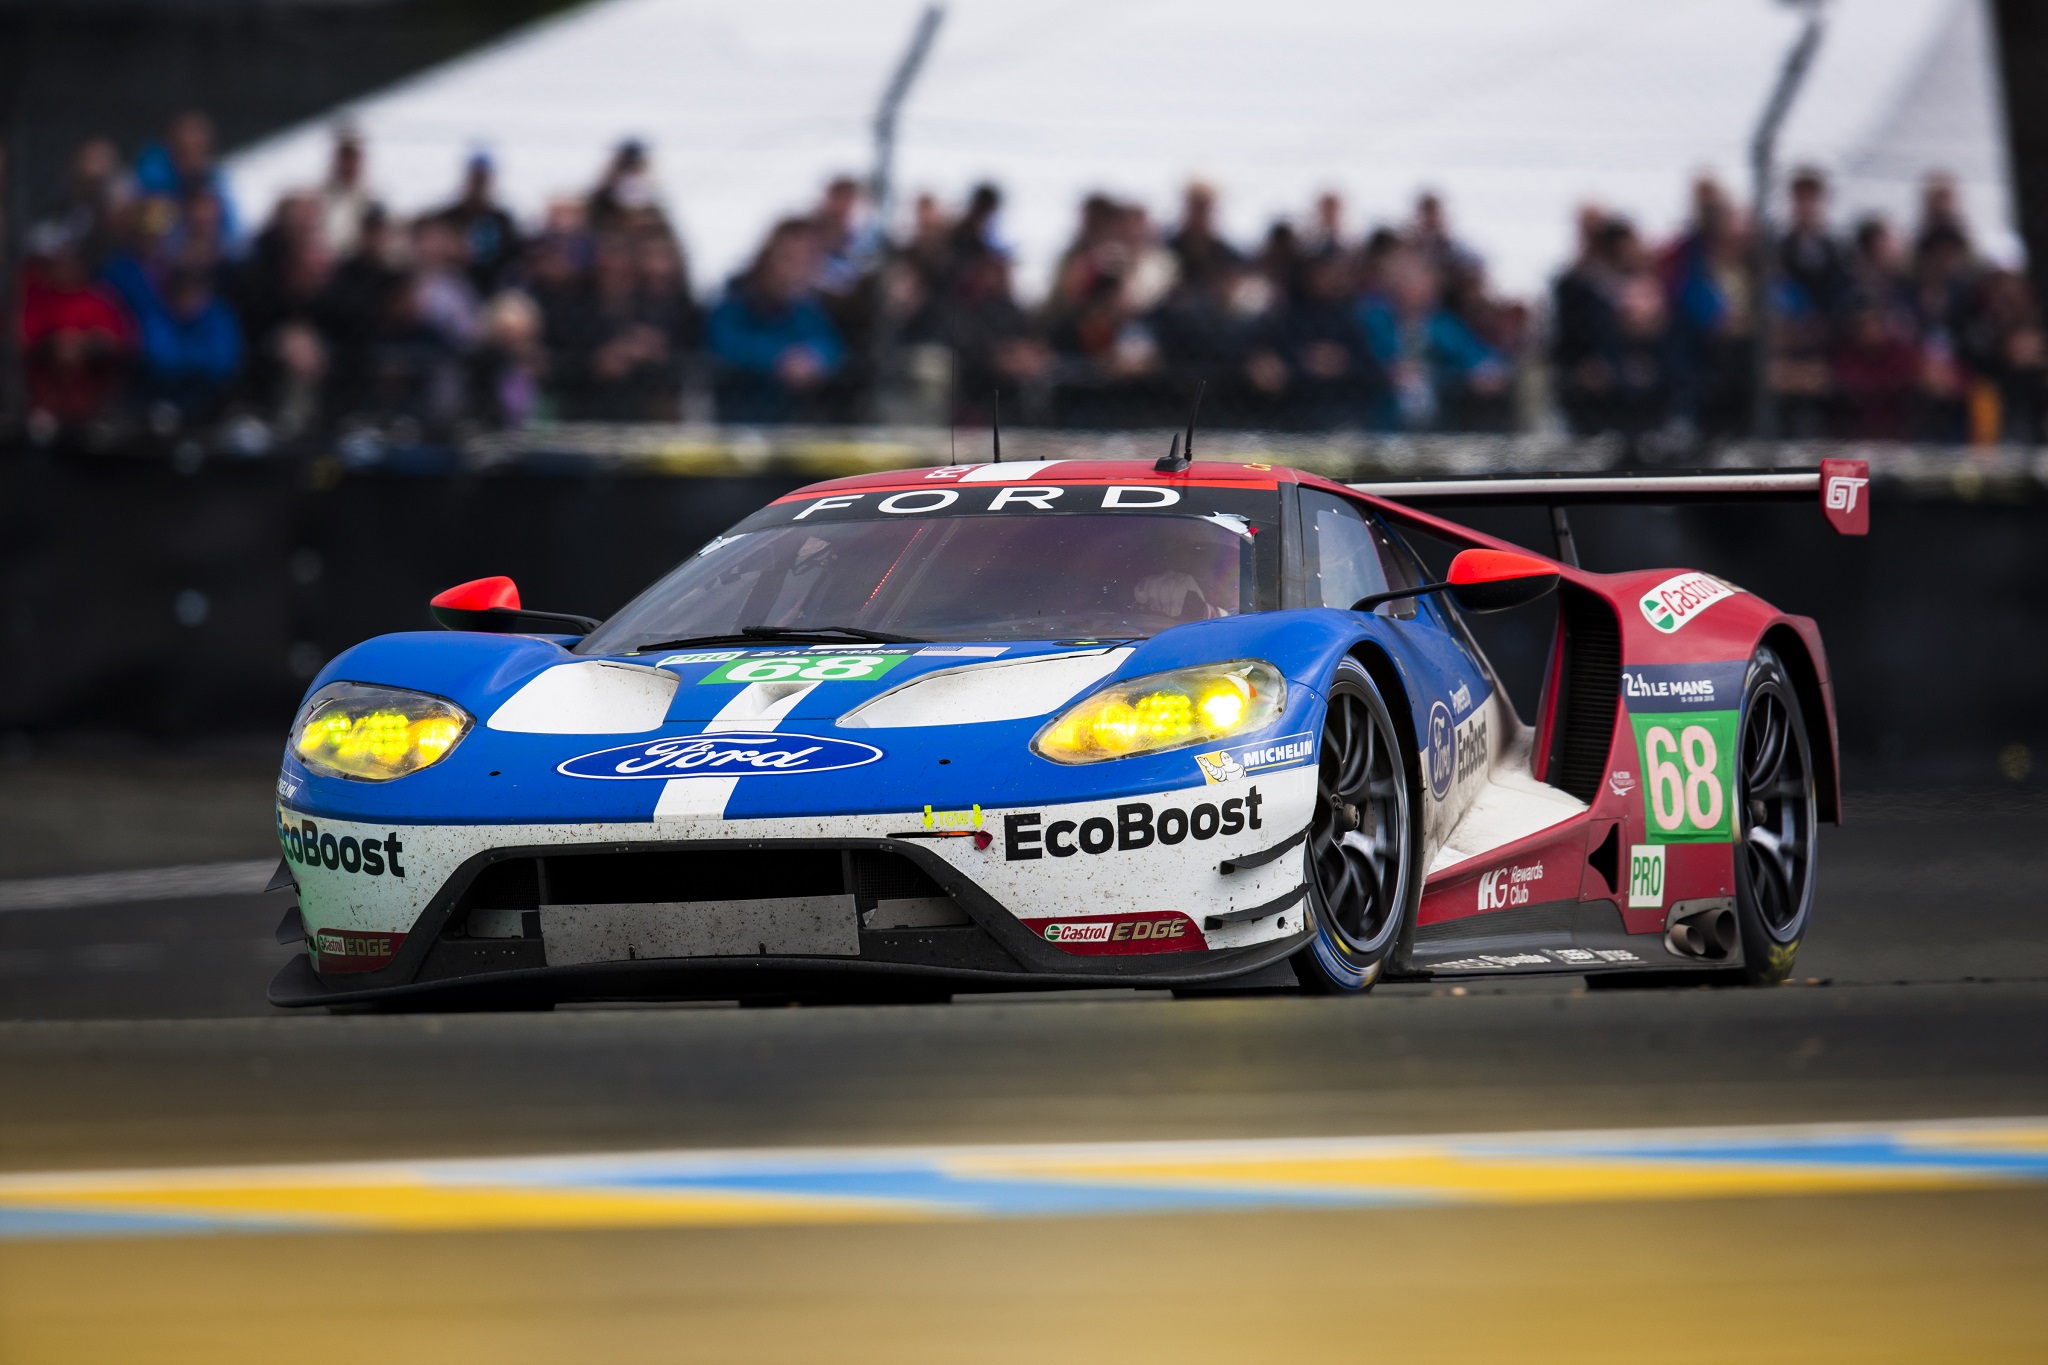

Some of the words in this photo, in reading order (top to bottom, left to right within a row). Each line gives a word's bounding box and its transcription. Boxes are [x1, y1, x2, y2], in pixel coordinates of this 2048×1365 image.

[792, 486, 1181, 520] FORD
[1826, 476, 1869, 514] GT
[664, 653, 738, 663] PRO
[725, 657, 884, 680] 68
[1651, 682, 1669, 696] LE
[1669, 680, 1714, 696] MANS
[615, 738, 823, 773] Ford
[1243, 740, 1312, 767] MICHELIN
[1434, 716, 1451, 783] Ford
[1457, 710, 1487, 785] EcoBoost
[1646, 725, 1723, 830] 68
[937, 811, 969, 826] TOW
[1004, 786, 1263, 861] EcoBoost
[1510, 860, 1543, 884] Rewards
[1631, 856, 1661, 896] PRO
[1510, 883, 1529, 905] Club
[1060, 925, 1107, 940] Castrol
[1112, 919, 1188, 941] EDGE
[346, 939, 392, 956] EDGE
